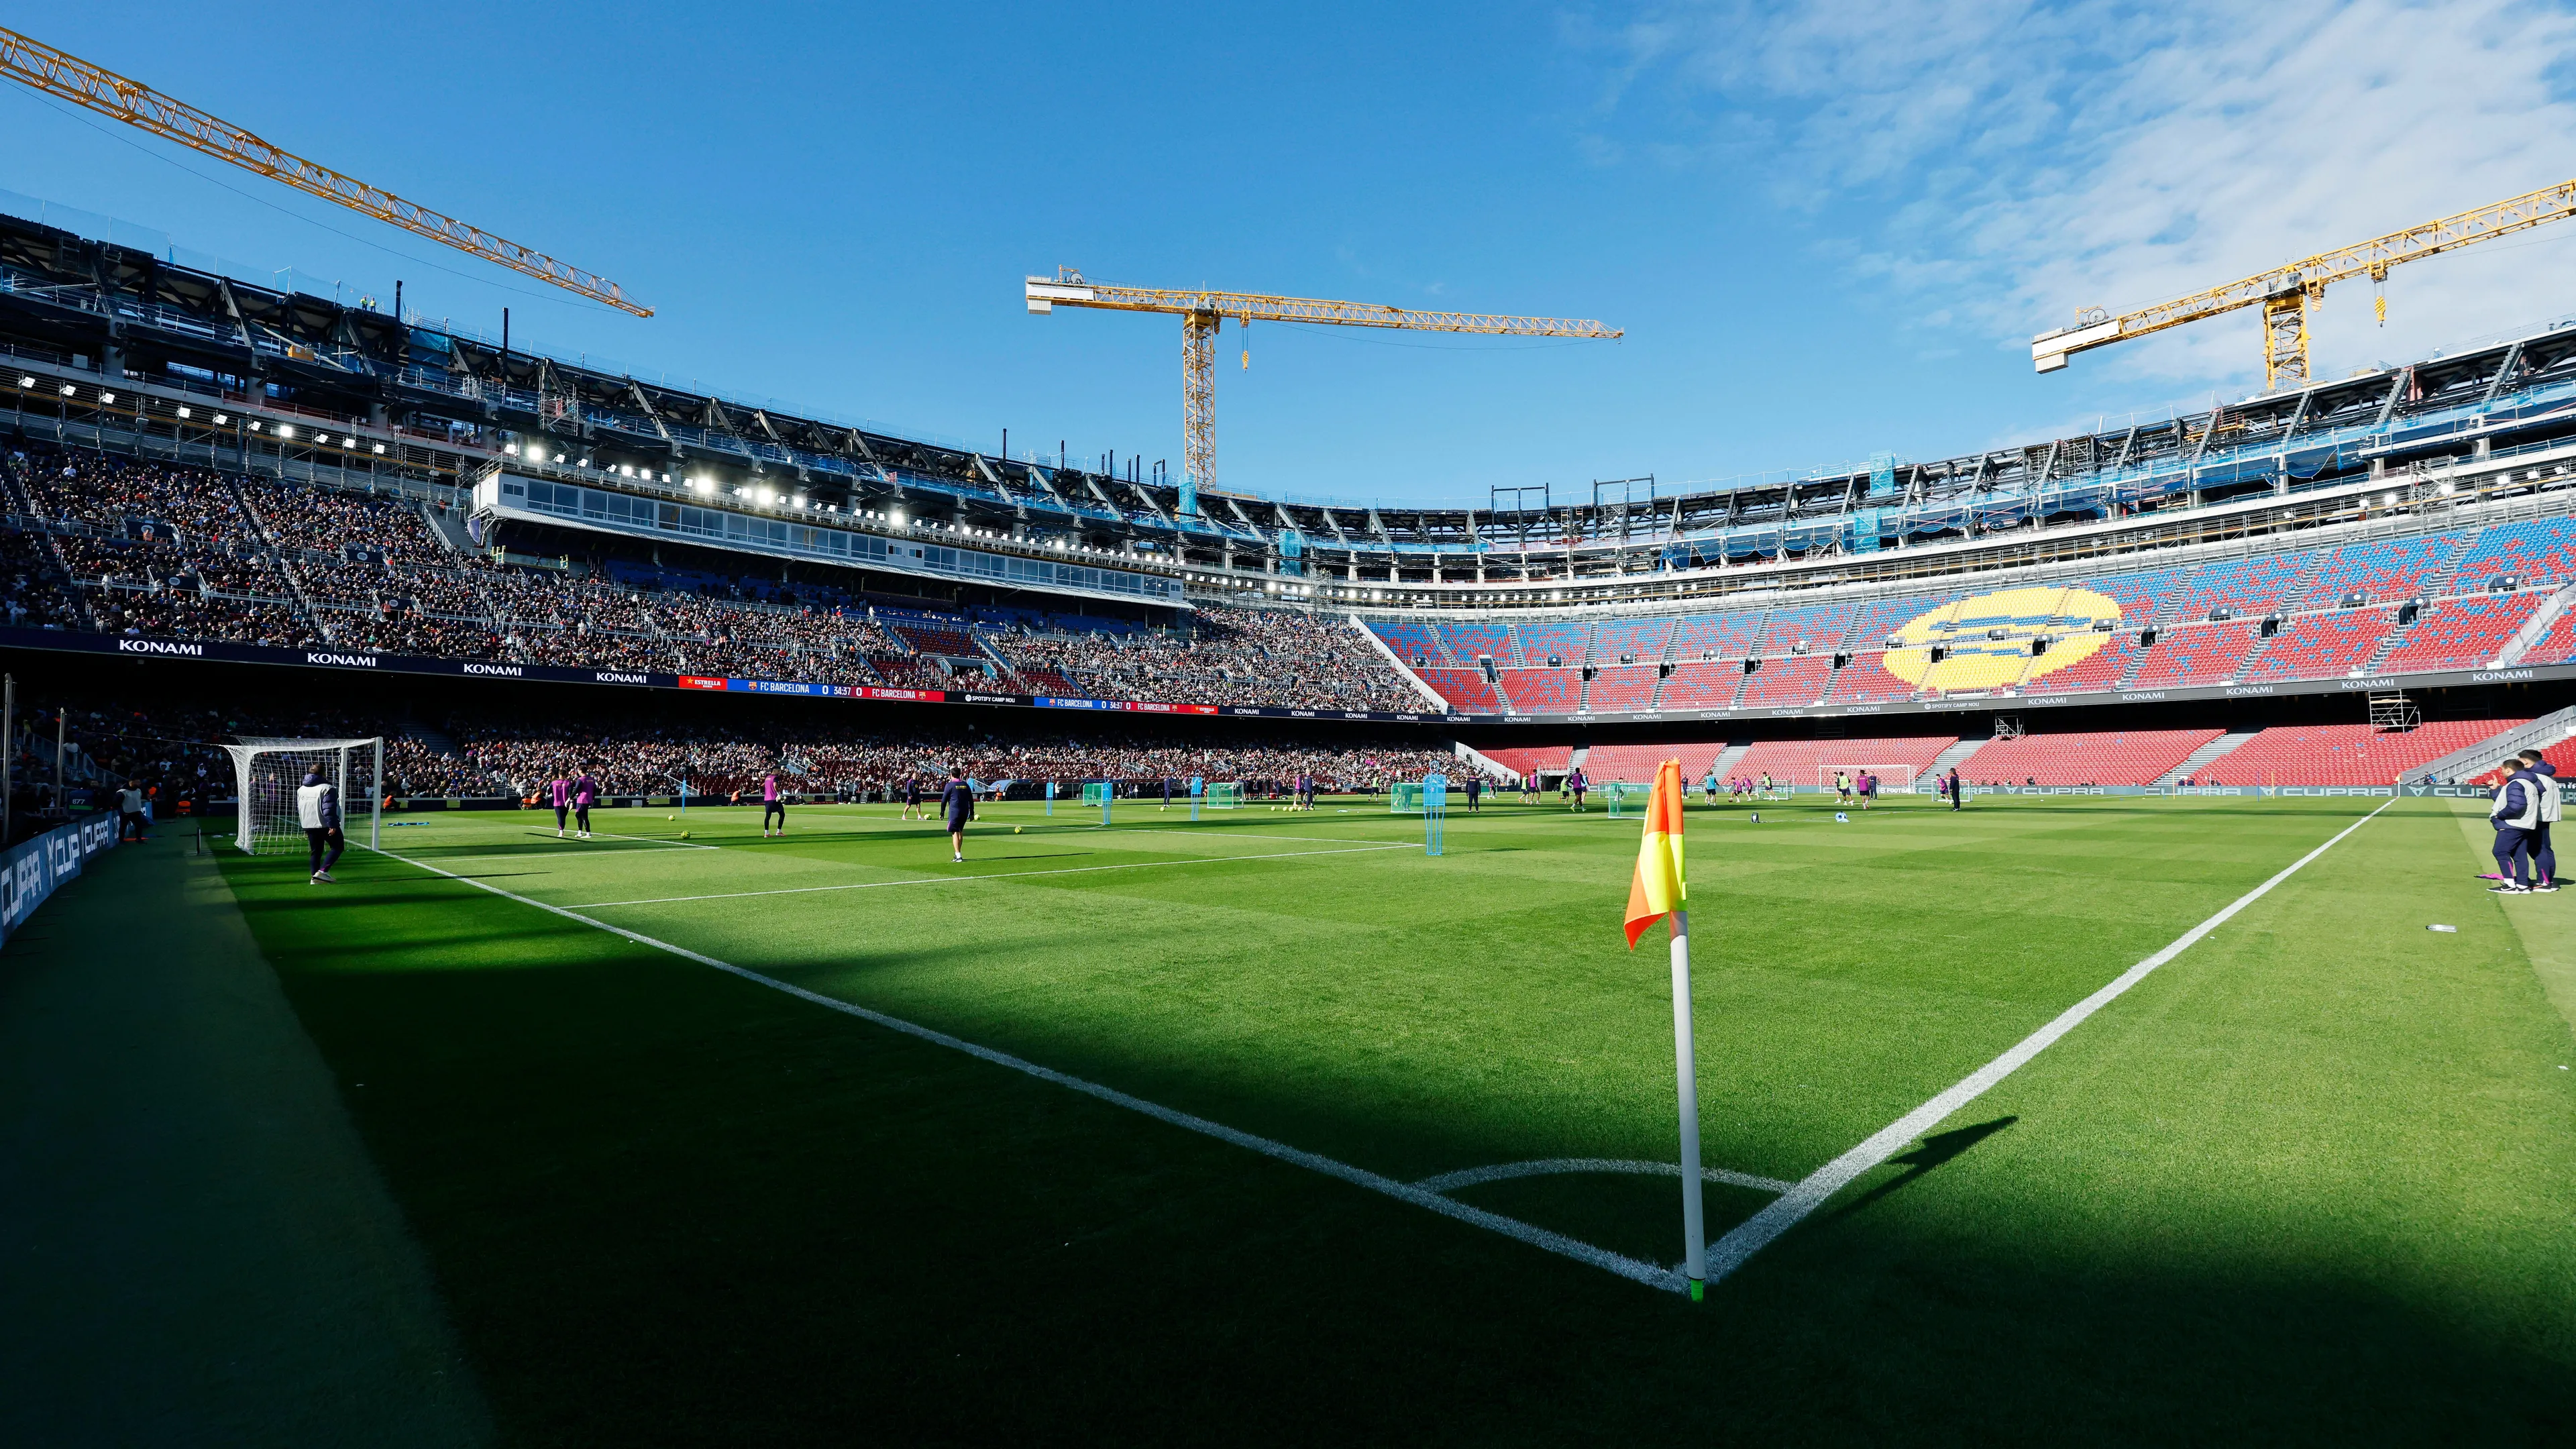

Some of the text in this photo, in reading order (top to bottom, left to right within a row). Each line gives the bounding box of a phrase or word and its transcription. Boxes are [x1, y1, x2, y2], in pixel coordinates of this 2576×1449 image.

[119, 639, 203, 655] KONAMI
[307, 653, 376, 667] KONAMI
[464, 663, 522, 677] KONAMI
[2472, 670, 2533, 682] KONAMI
[596, 672, 647, 684] KONAMI
[2341, 679, 2395, 689] KONAMI
[760, 682, 916, 699] FC BARCELONA 0 34:37 0 FC BARCELONA
[2122, 692, 2165, 700] KONAMI
[2226, 686, 2273, 695] KONAMI
[1065, 700, 1093, 708] BARCELONA
[1102, 701, 1107, 709] 0
[1144, 703, 1170, 712] BARCELONA
[2145, 788, 2241, 796] CUPRA
[2282, 788, 2392, 796] CUPRA
[85, 820, 109, 854] CUPRA
[1, 850, 42, 926] CUPRA
